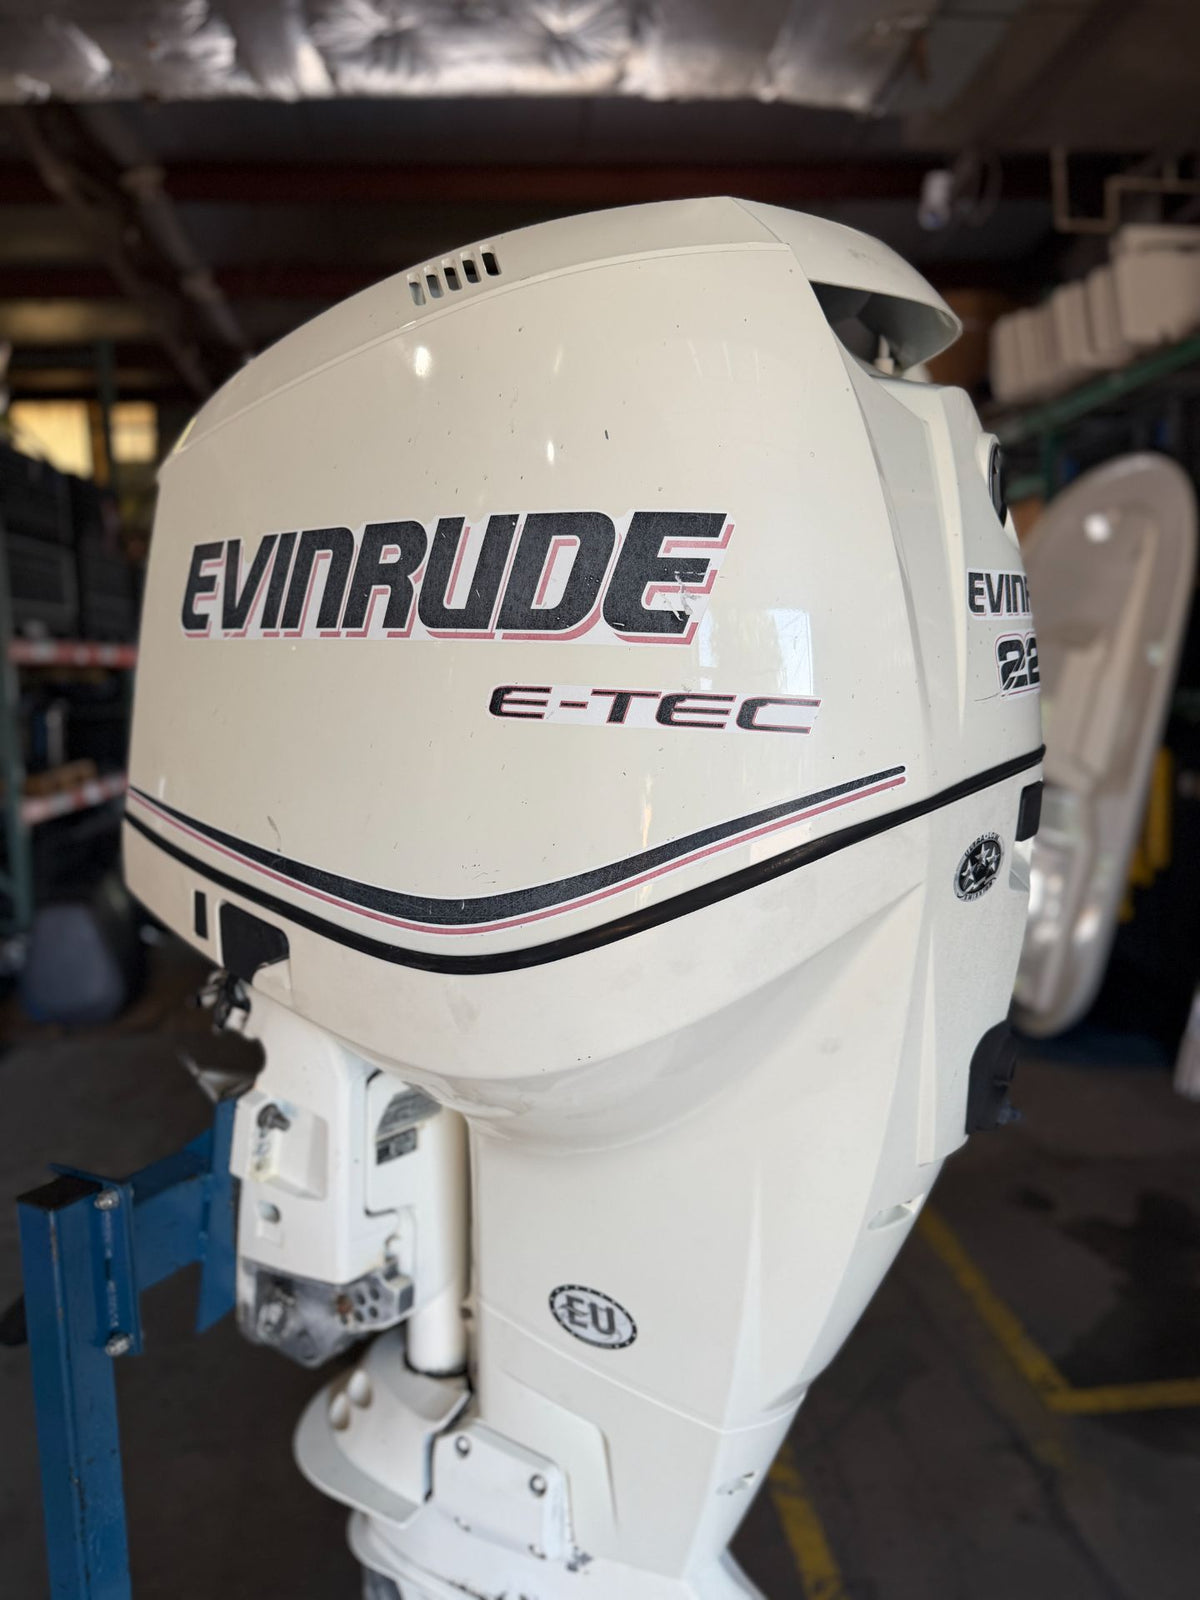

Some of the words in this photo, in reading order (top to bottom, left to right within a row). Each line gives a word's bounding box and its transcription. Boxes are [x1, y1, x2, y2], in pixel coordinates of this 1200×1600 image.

[182, 511, 735, 645] EVINRUDE
[489, 685, 821, 734] E-TEC
[565, 1294, 616, 1335] EU
